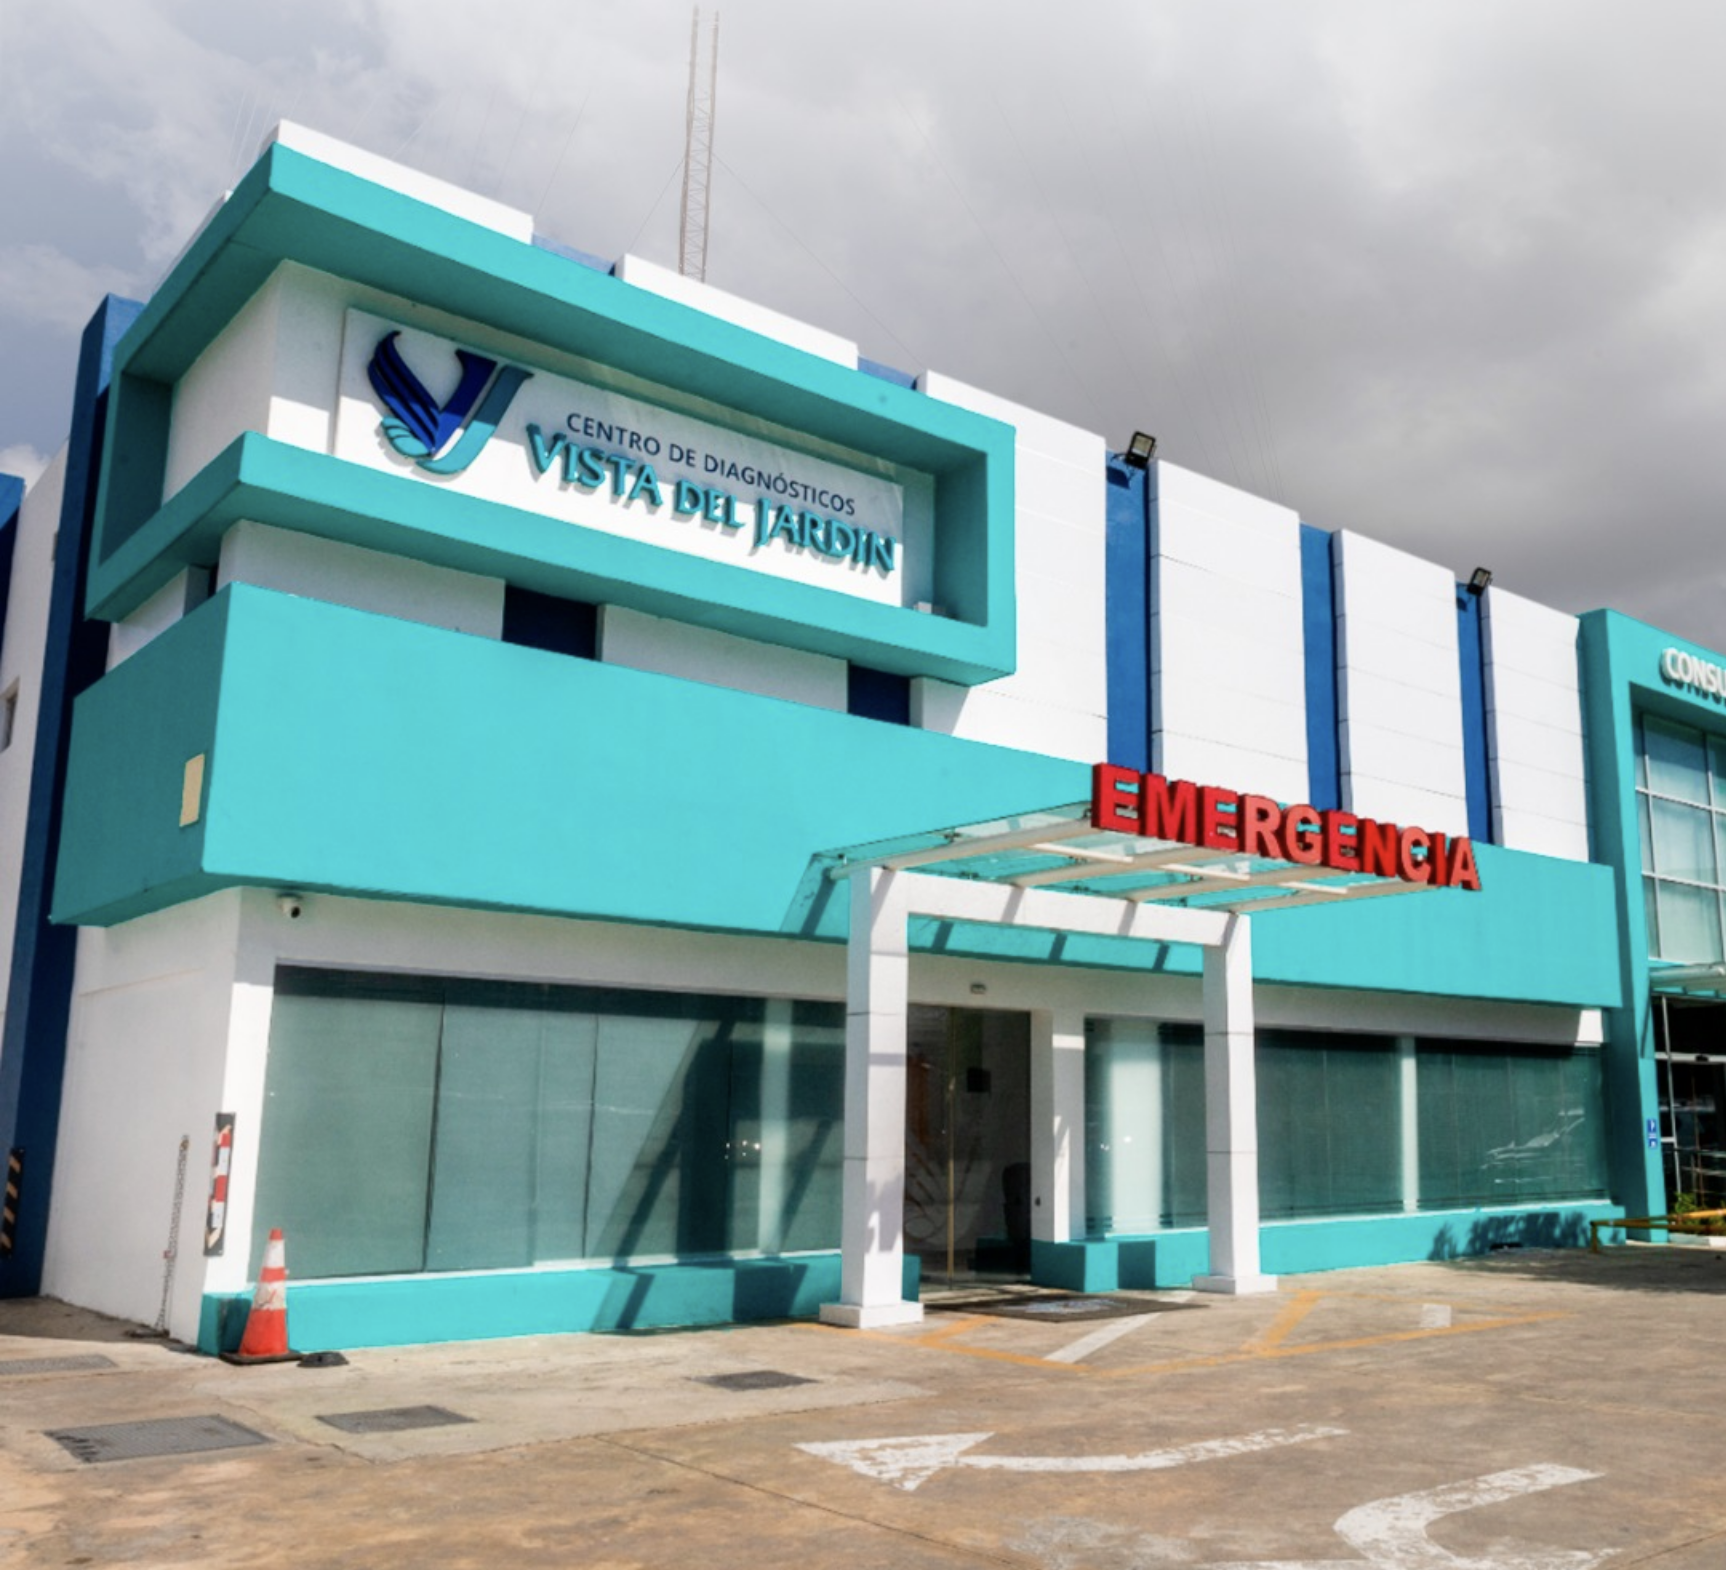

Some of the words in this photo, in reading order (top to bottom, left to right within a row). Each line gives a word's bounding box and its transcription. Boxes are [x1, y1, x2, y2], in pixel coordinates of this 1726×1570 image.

[526, 423, 663, 506] VISTA
[676, 478, 746, 528] DEL
[754, 497, 894, 571] JARDIN
[566, 413, 661, 456] CENTRO
[669, 443, 697, 468] DE
[704, 454, 855, 516] DIAGNÓSTICOS
[1091, 761, 1482, 891] EMERGENCIA
